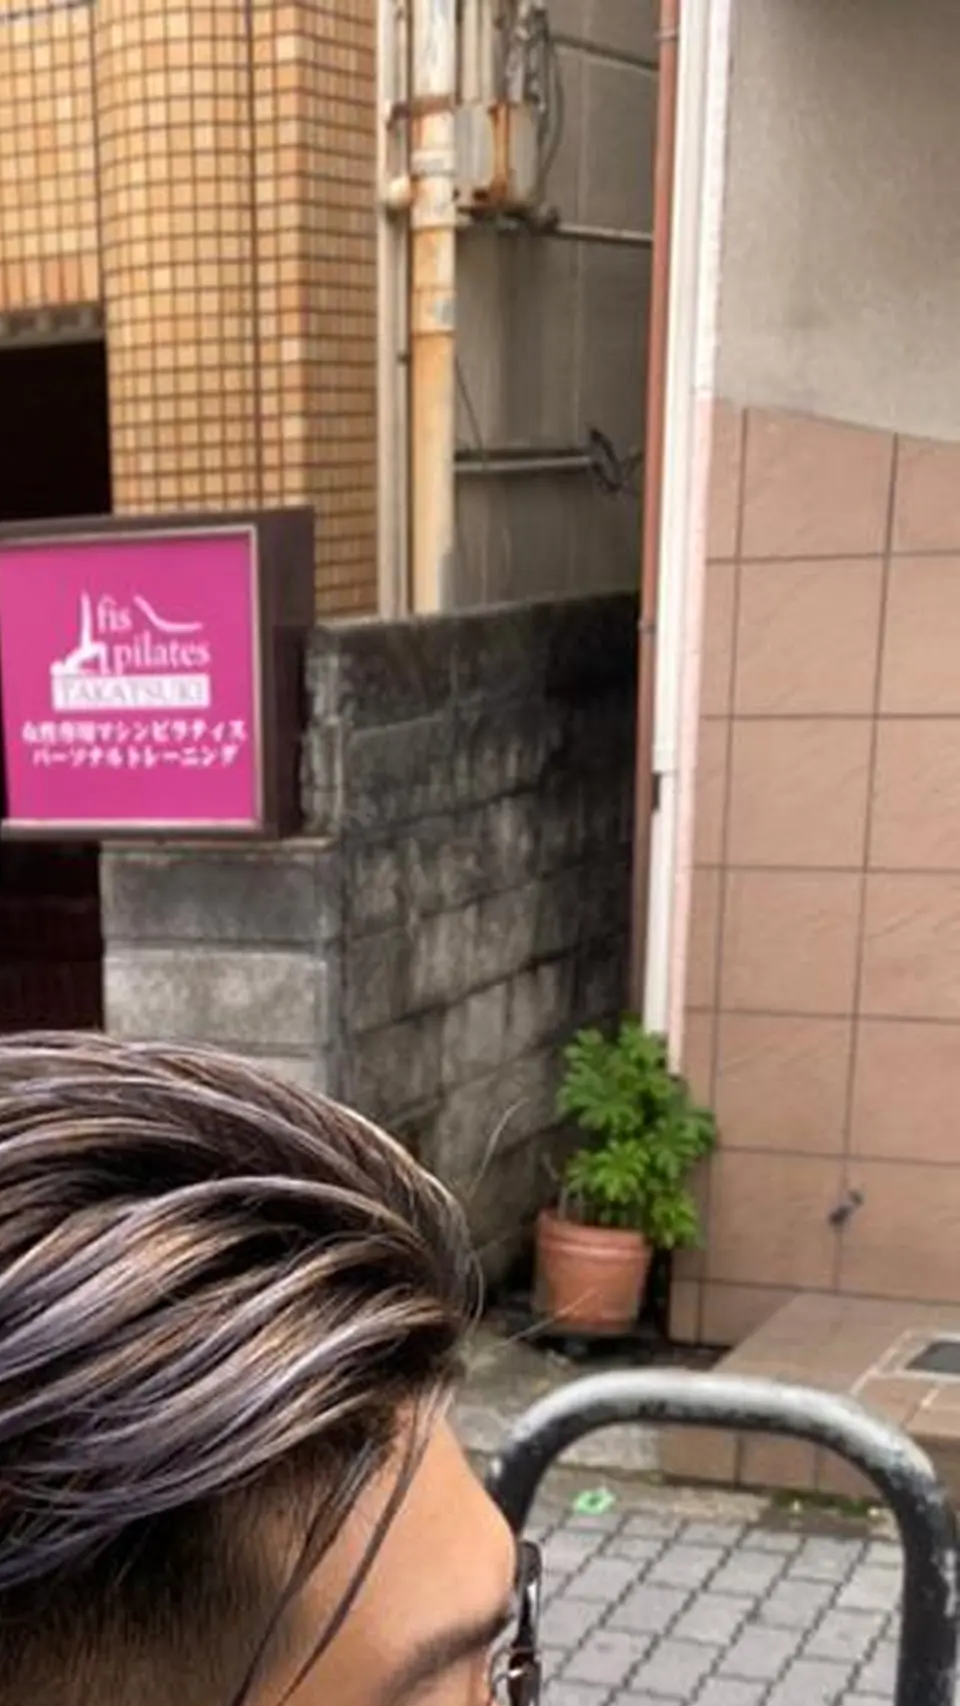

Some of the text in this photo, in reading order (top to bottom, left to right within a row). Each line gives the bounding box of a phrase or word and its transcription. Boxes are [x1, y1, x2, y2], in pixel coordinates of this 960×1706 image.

[112, 631, 211, 677] pilates
[33, 744, 240, 768] パーソナルトレーニング
